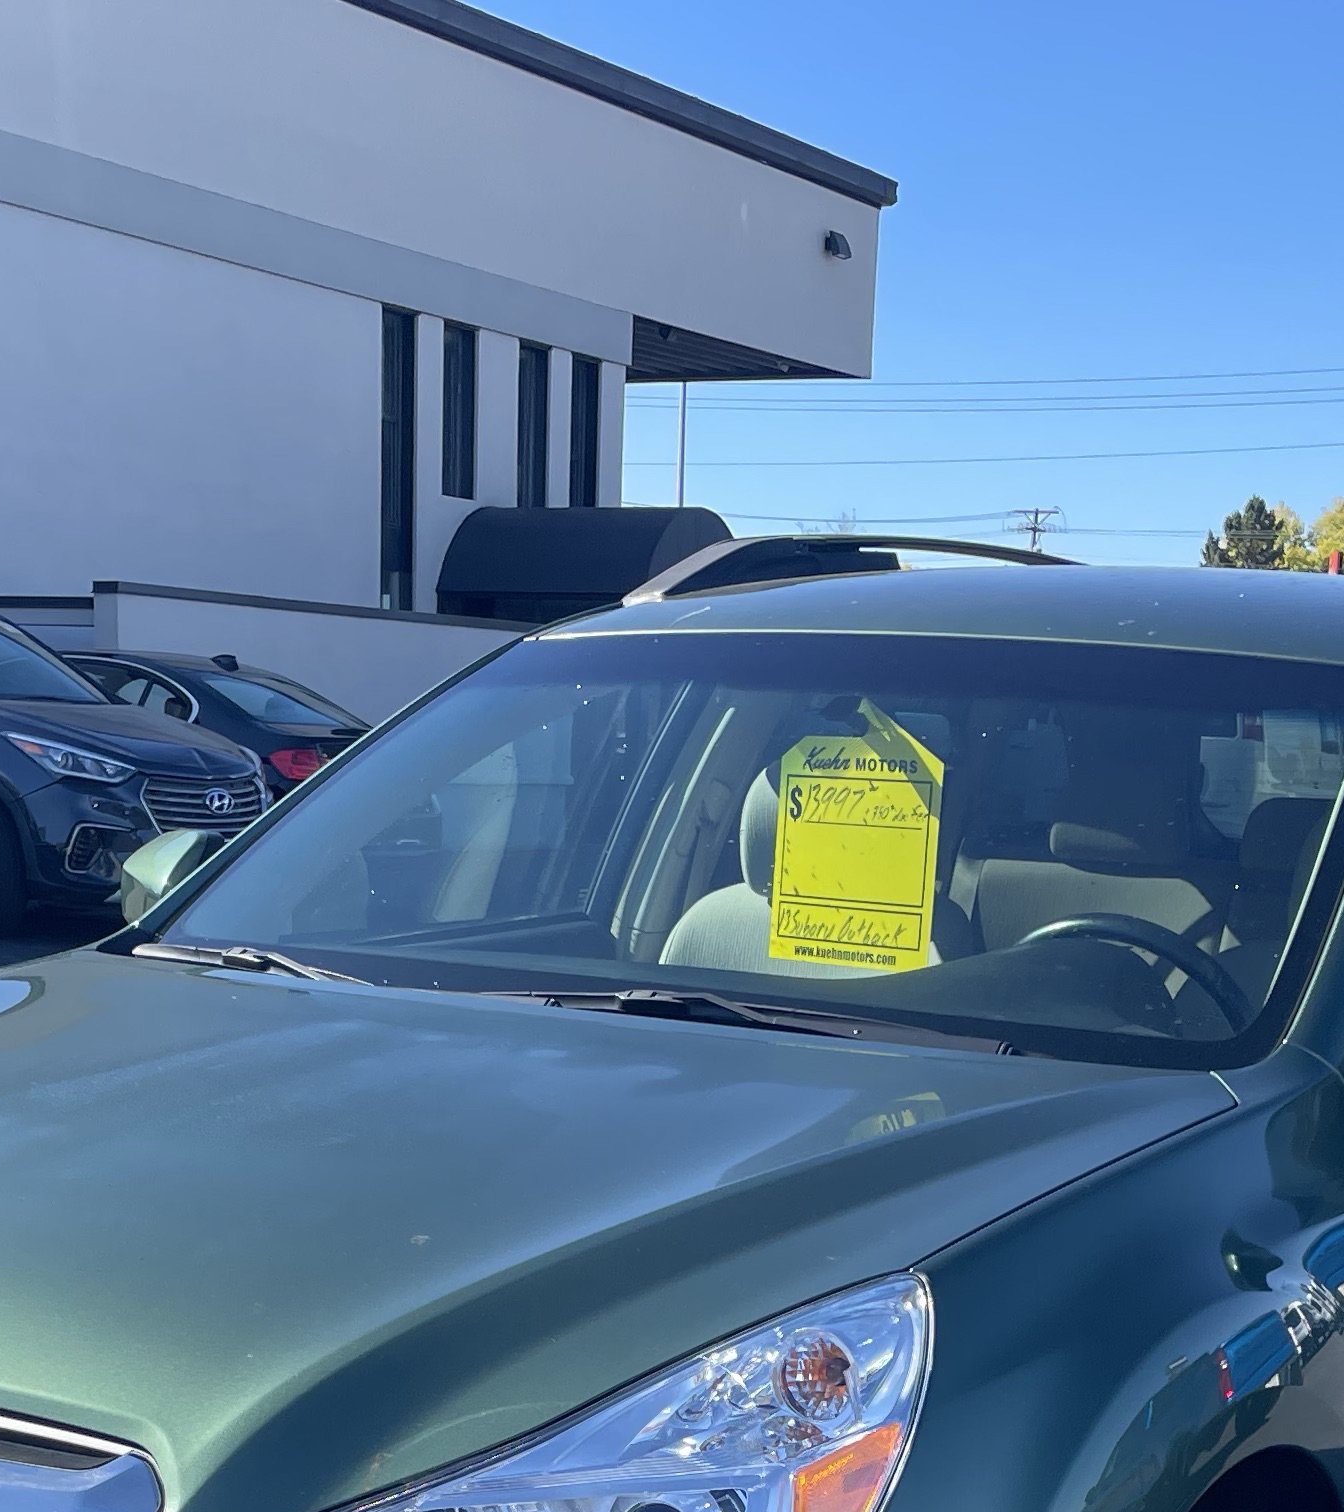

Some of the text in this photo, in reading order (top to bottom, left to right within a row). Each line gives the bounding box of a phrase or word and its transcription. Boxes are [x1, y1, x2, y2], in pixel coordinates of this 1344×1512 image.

[803, 746, 918, 774] Kuehn MOTORS
[794, 945, 897, 966] www.kuehnmotors.com
